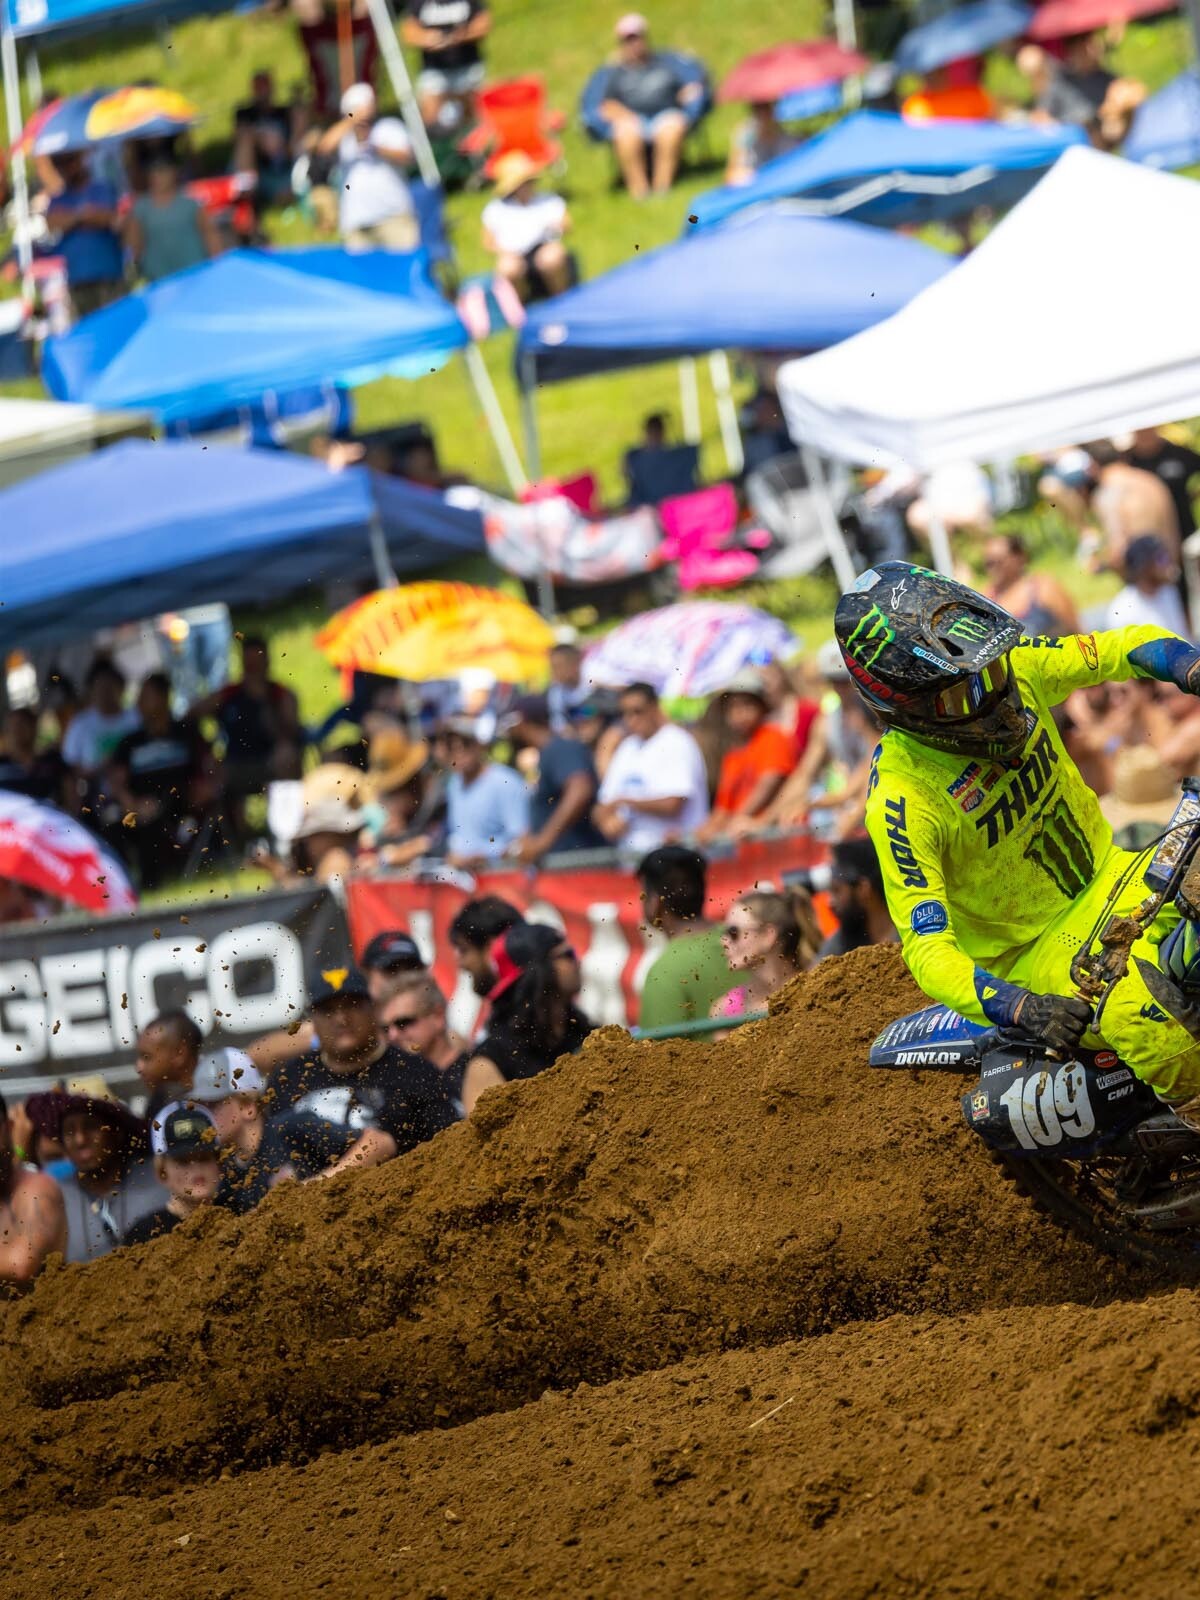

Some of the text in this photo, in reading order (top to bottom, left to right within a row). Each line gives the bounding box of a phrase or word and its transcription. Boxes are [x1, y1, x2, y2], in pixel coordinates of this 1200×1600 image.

[976, 728, 1059, 849] THOR
[885, 796, 928, 888] THOR
[0, 920, 305, 1066] GEICO
[894, 1052, 961, 1066] DUNLOP
[974, 1095, 987, 1111] 50
[983, 1063, 1012, 1079] FARRES
[1000, 1060, 1095, 1149] 109
